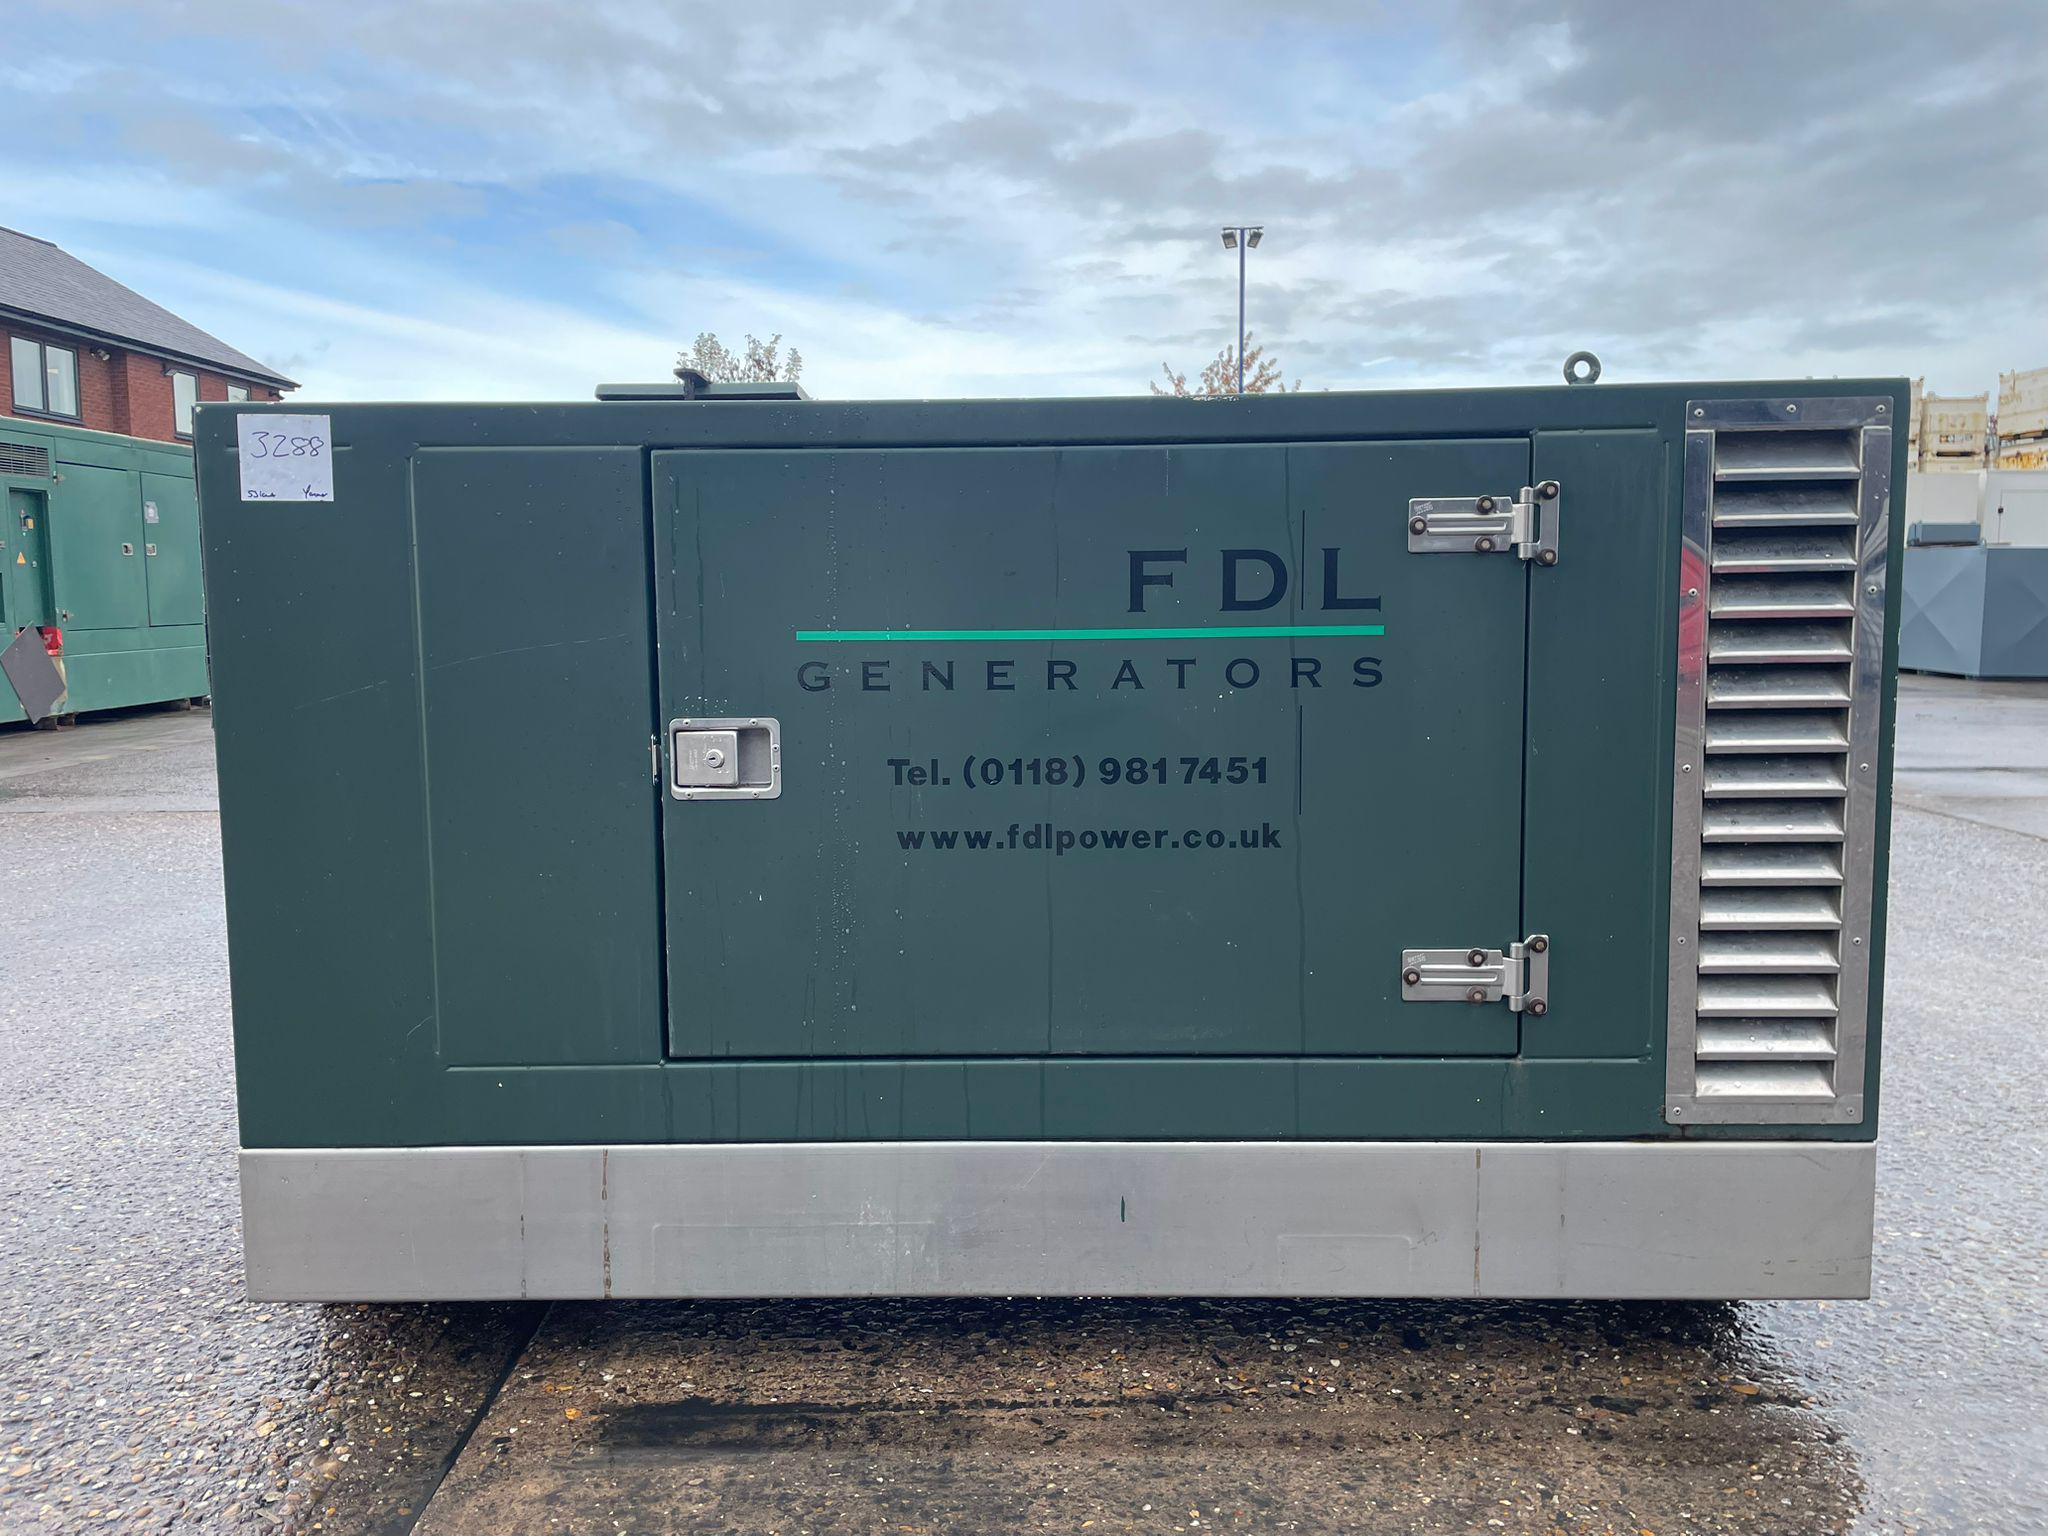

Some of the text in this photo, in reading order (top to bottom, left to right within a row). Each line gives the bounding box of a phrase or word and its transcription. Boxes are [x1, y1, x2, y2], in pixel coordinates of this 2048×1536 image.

[250, 431, 325, 459] 3288
[1128, 547, 1382, 612] FDL
[797, 657, 1383, 692] GENERATORS
[887, 758, 951, 786] Tel.
[963, 754, 1086, 788] (0118)
[896, 822, 1282, 856] www.fdlpower.co.uk
